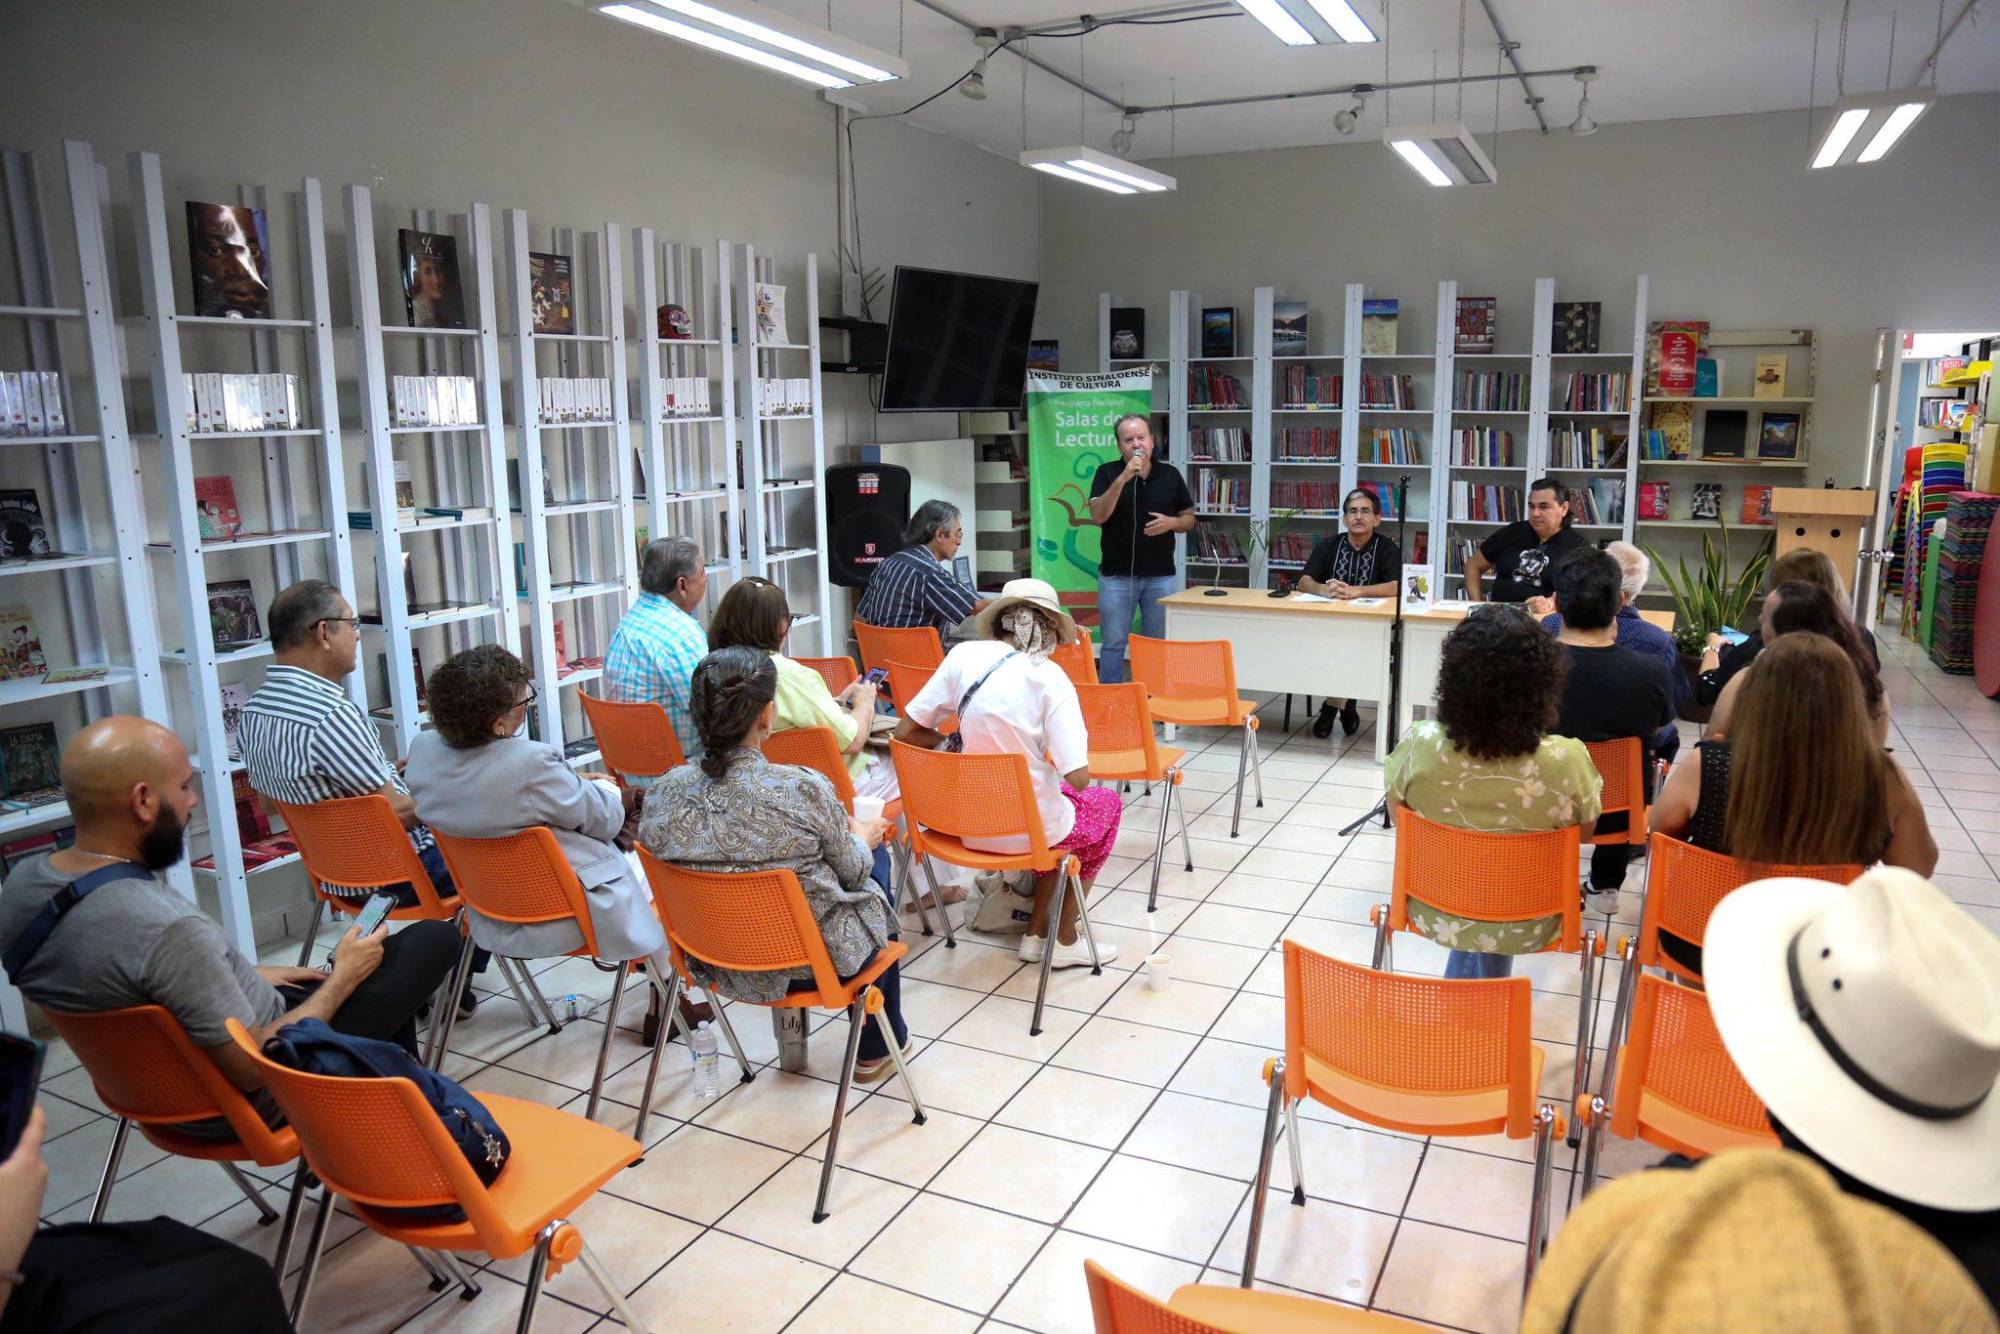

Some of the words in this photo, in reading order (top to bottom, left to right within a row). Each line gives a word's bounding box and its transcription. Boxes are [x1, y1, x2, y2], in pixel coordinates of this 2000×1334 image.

[1030, 371, 1083, 382] INSTITUTO
[1086, 369, 1150, 382] SINALOENSE
[1060, 380, 1073, 389] DE
[1076, 379, 1121, 390] CULTURA
[1056, 410, 1099, 427] Salas
[1056, 430, 1117, 447] Lectur
[781, 1015, 801, 1034] Lily
